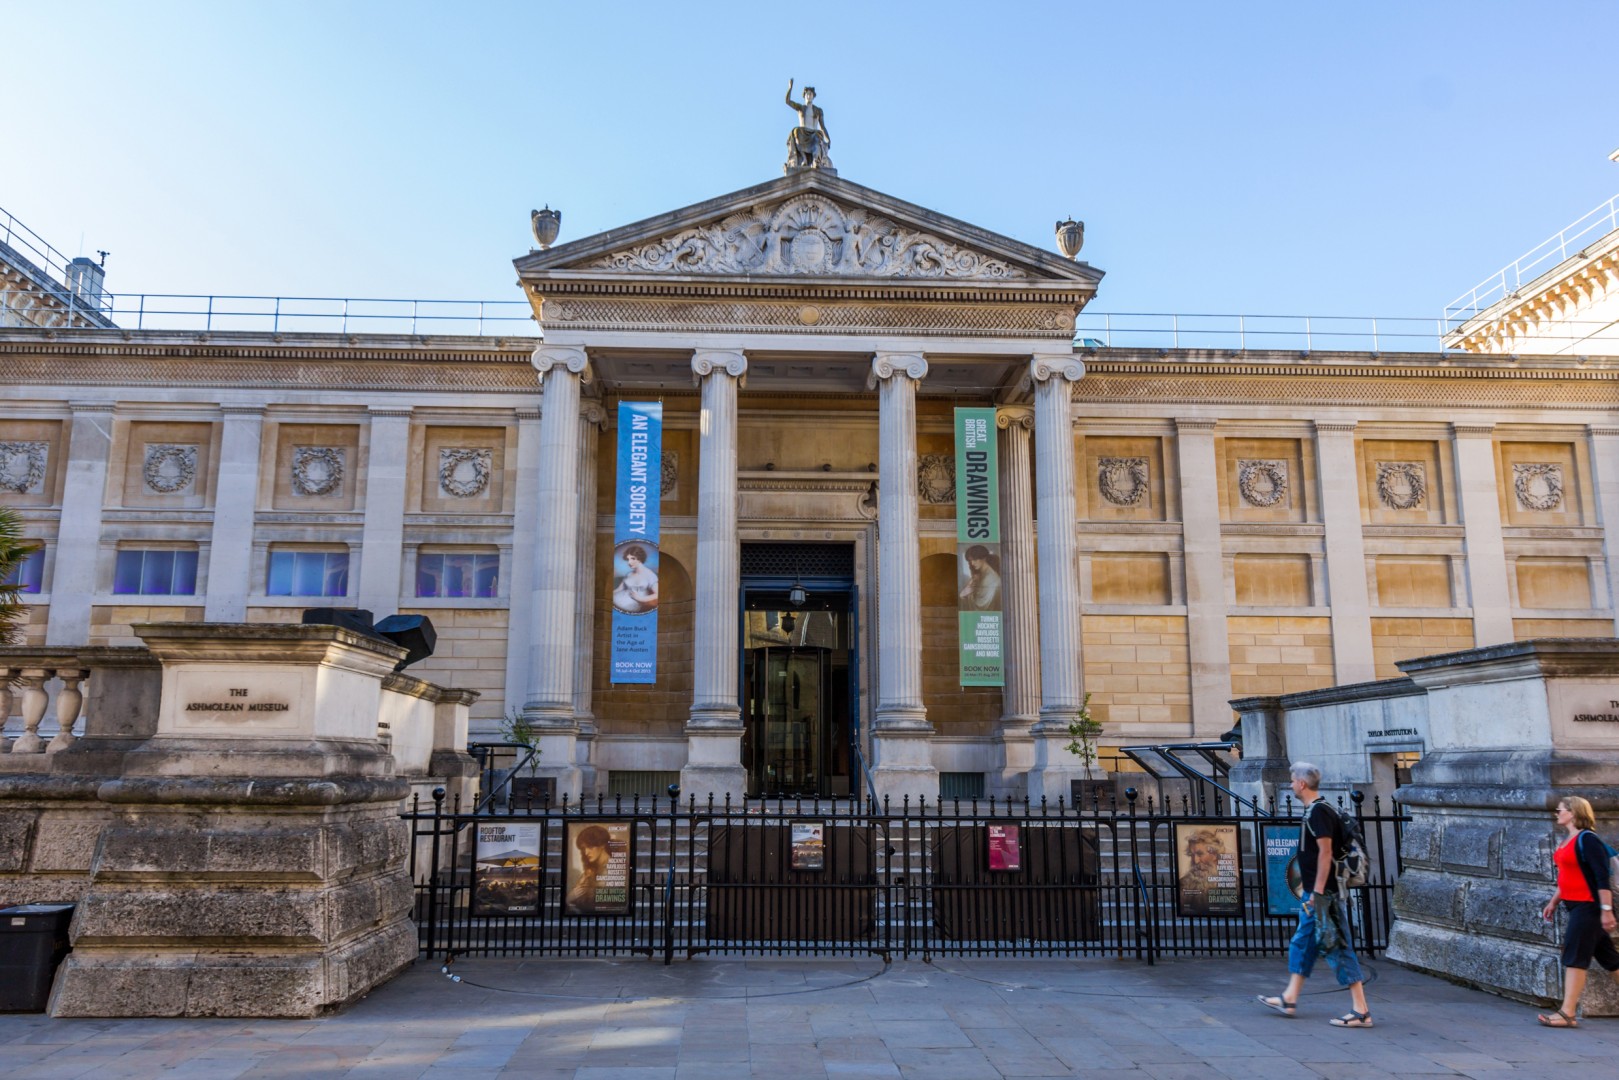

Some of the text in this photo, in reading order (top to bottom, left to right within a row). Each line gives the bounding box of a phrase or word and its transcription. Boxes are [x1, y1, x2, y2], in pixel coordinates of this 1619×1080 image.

[965, 419, 976, 448] BRITISH
[976, 419, 986, 442] GREAT
[629, 414, 648, 534] AN ELEGANT SOCIETY
[966, 452, 989, 538] DRAWINGS
[229, 688, 248, 696] THE
[186, 703, 243, 711] ASHMOLEAN
[1573, 714, 1619, 722] ASHMOLEA
